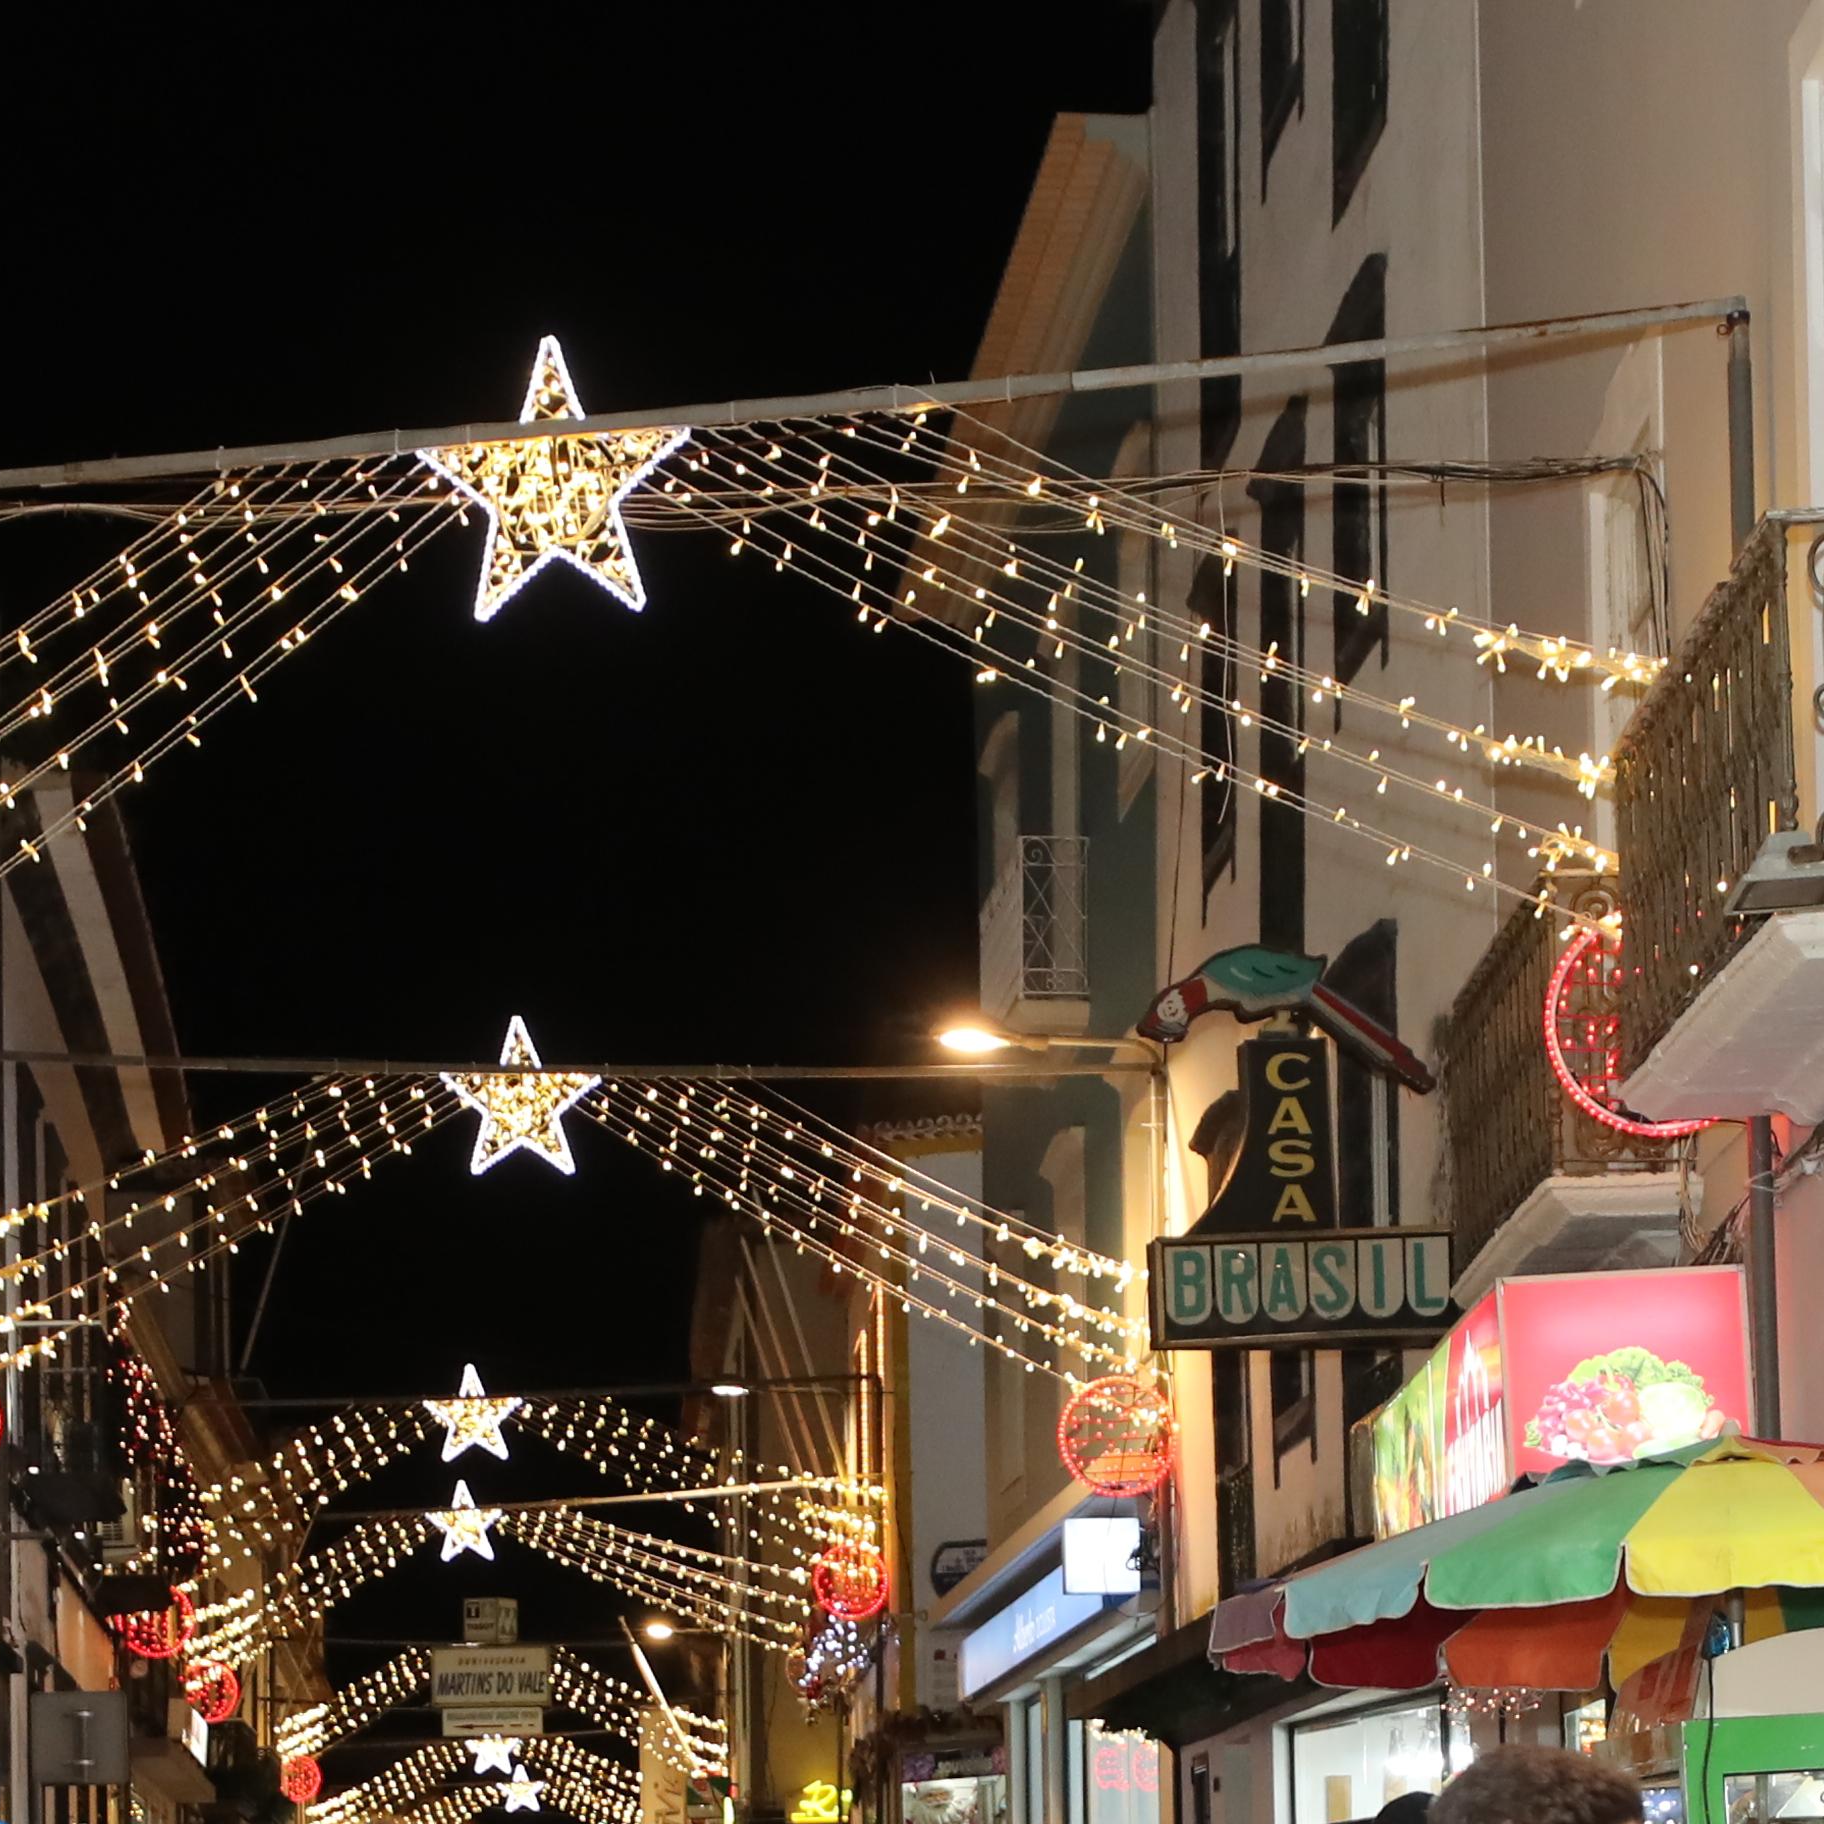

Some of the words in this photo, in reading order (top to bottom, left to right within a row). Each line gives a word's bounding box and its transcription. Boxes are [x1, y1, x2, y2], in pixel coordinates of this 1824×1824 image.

[1267, 1053, 1317, 1223] CASA
[1171, 1242, 1446, 1318] BRASIL
[437, 1672, 492, 1696] MARTINS
[497, 1672, 513, 1695] DO
[518, 1671, 546, 1694] VALE
